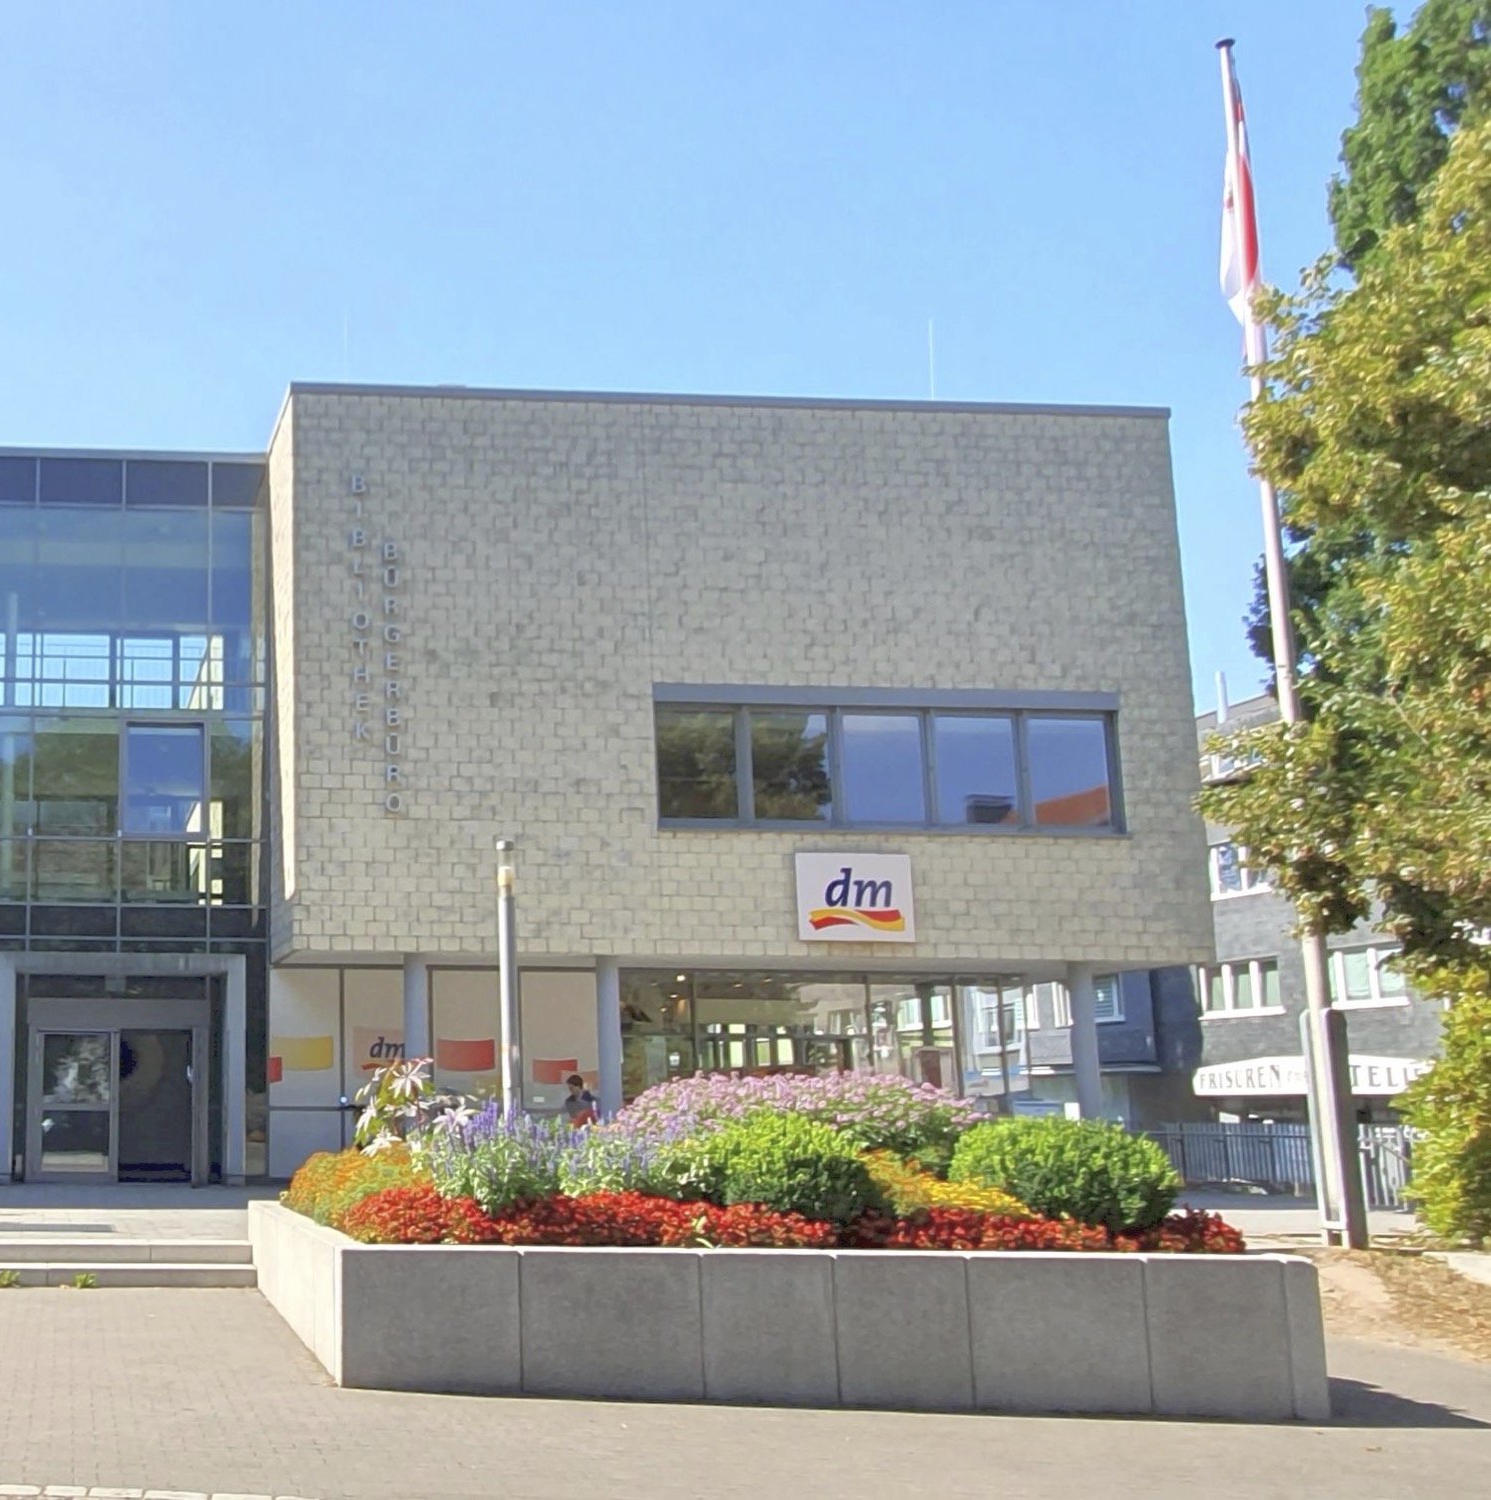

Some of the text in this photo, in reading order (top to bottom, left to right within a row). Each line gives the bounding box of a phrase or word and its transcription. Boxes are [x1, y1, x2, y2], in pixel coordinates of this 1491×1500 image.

[351, 474, 370, 741] BIBLIOTHEK
[825, 867, 892, 907] dm
[370, 1036, 405, 1058] dm
[1200, 1065, 1281, 1089] FRISUREN
